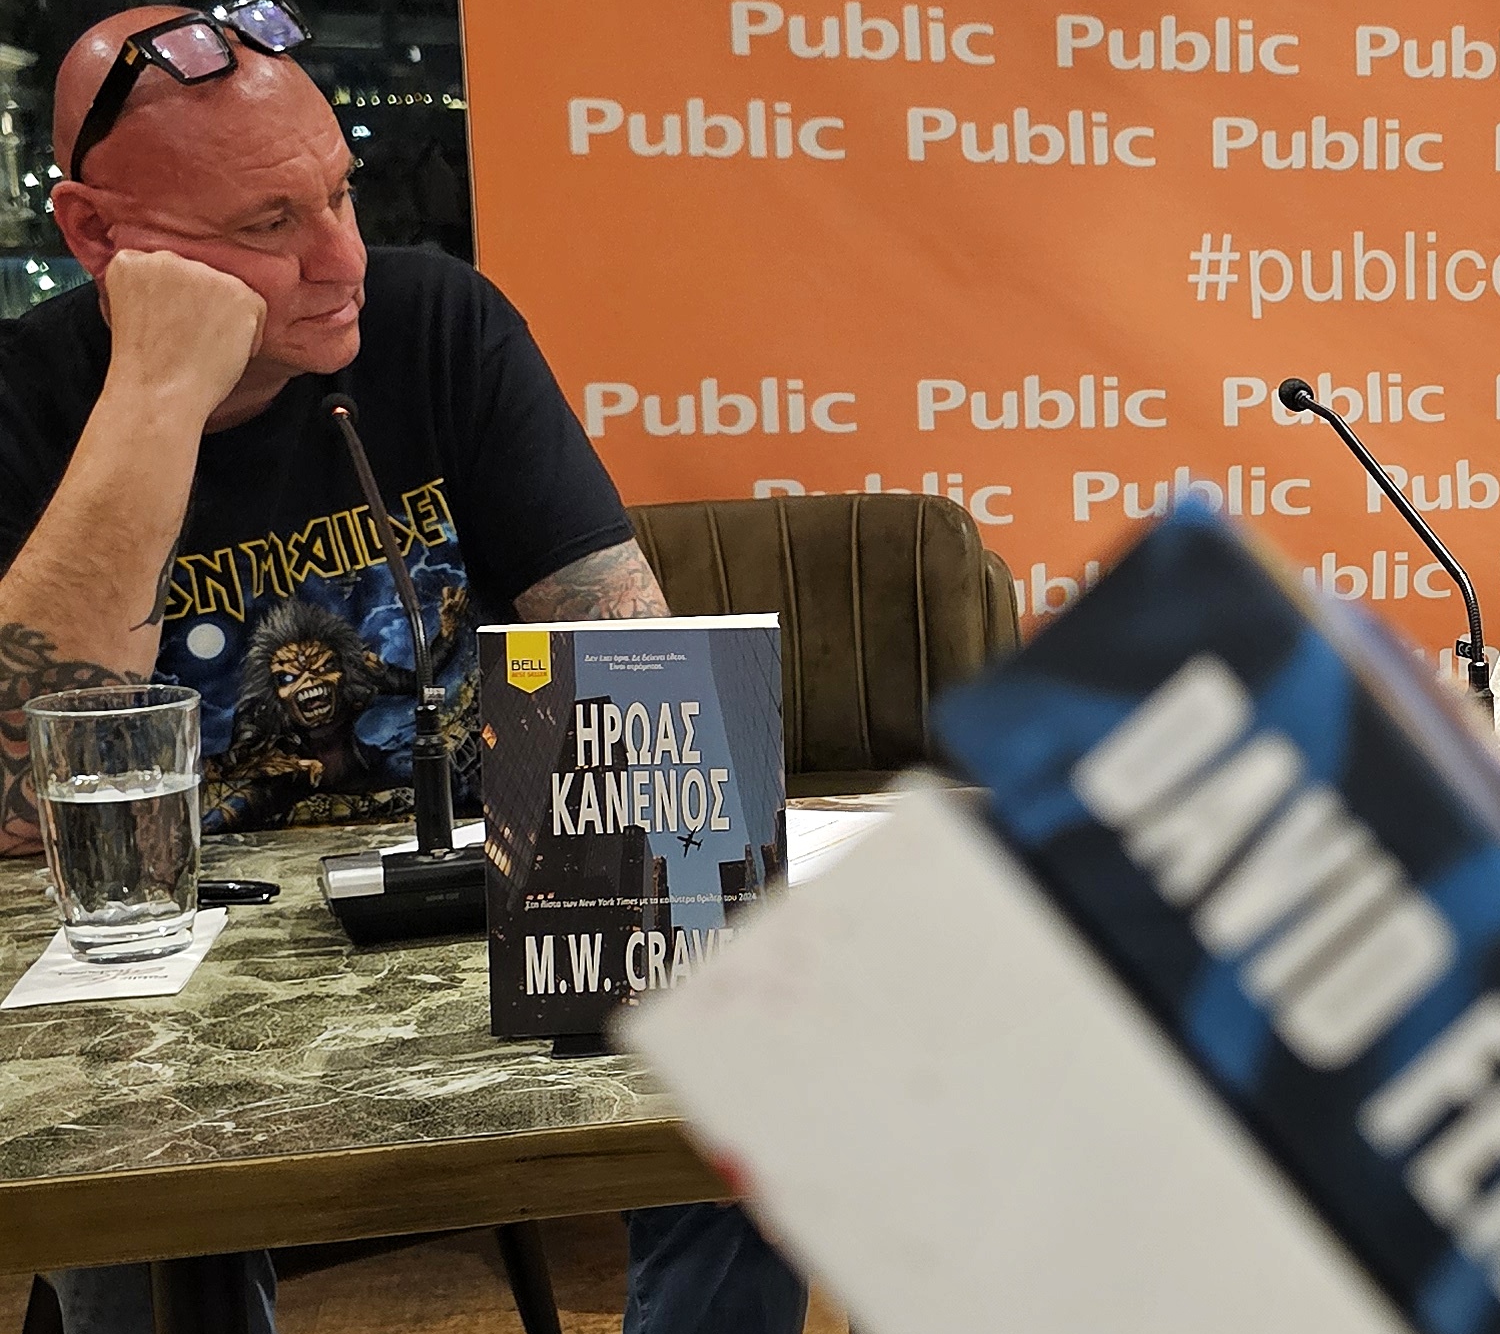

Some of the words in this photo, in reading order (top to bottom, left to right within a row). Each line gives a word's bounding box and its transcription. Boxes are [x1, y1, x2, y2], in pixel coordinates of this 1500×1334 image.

[731, 1, 995, 65] Public
[1057, 15, 1299, 75] Public
[569, 99, 845, 159] Public
[907, 107, 1156, 167] Public
[1213, 116, 1443, 171] Public
[584, 377, 857, 437] Public
[918, 374, 1167, 430] Public
[1223, 372, 1445, 426] Public
[512, 659, 547, 671] BELL
[576, 701, 701, 767] ΗΡΩΑΣ
[552, 768, 730, 836] ΚΑΝΕΝΟΣ
[1072, 653, 1454, 1070] DAVID
[525, 933, 613, 995] M.W.
[625, 928, 735, 992] CRAV
